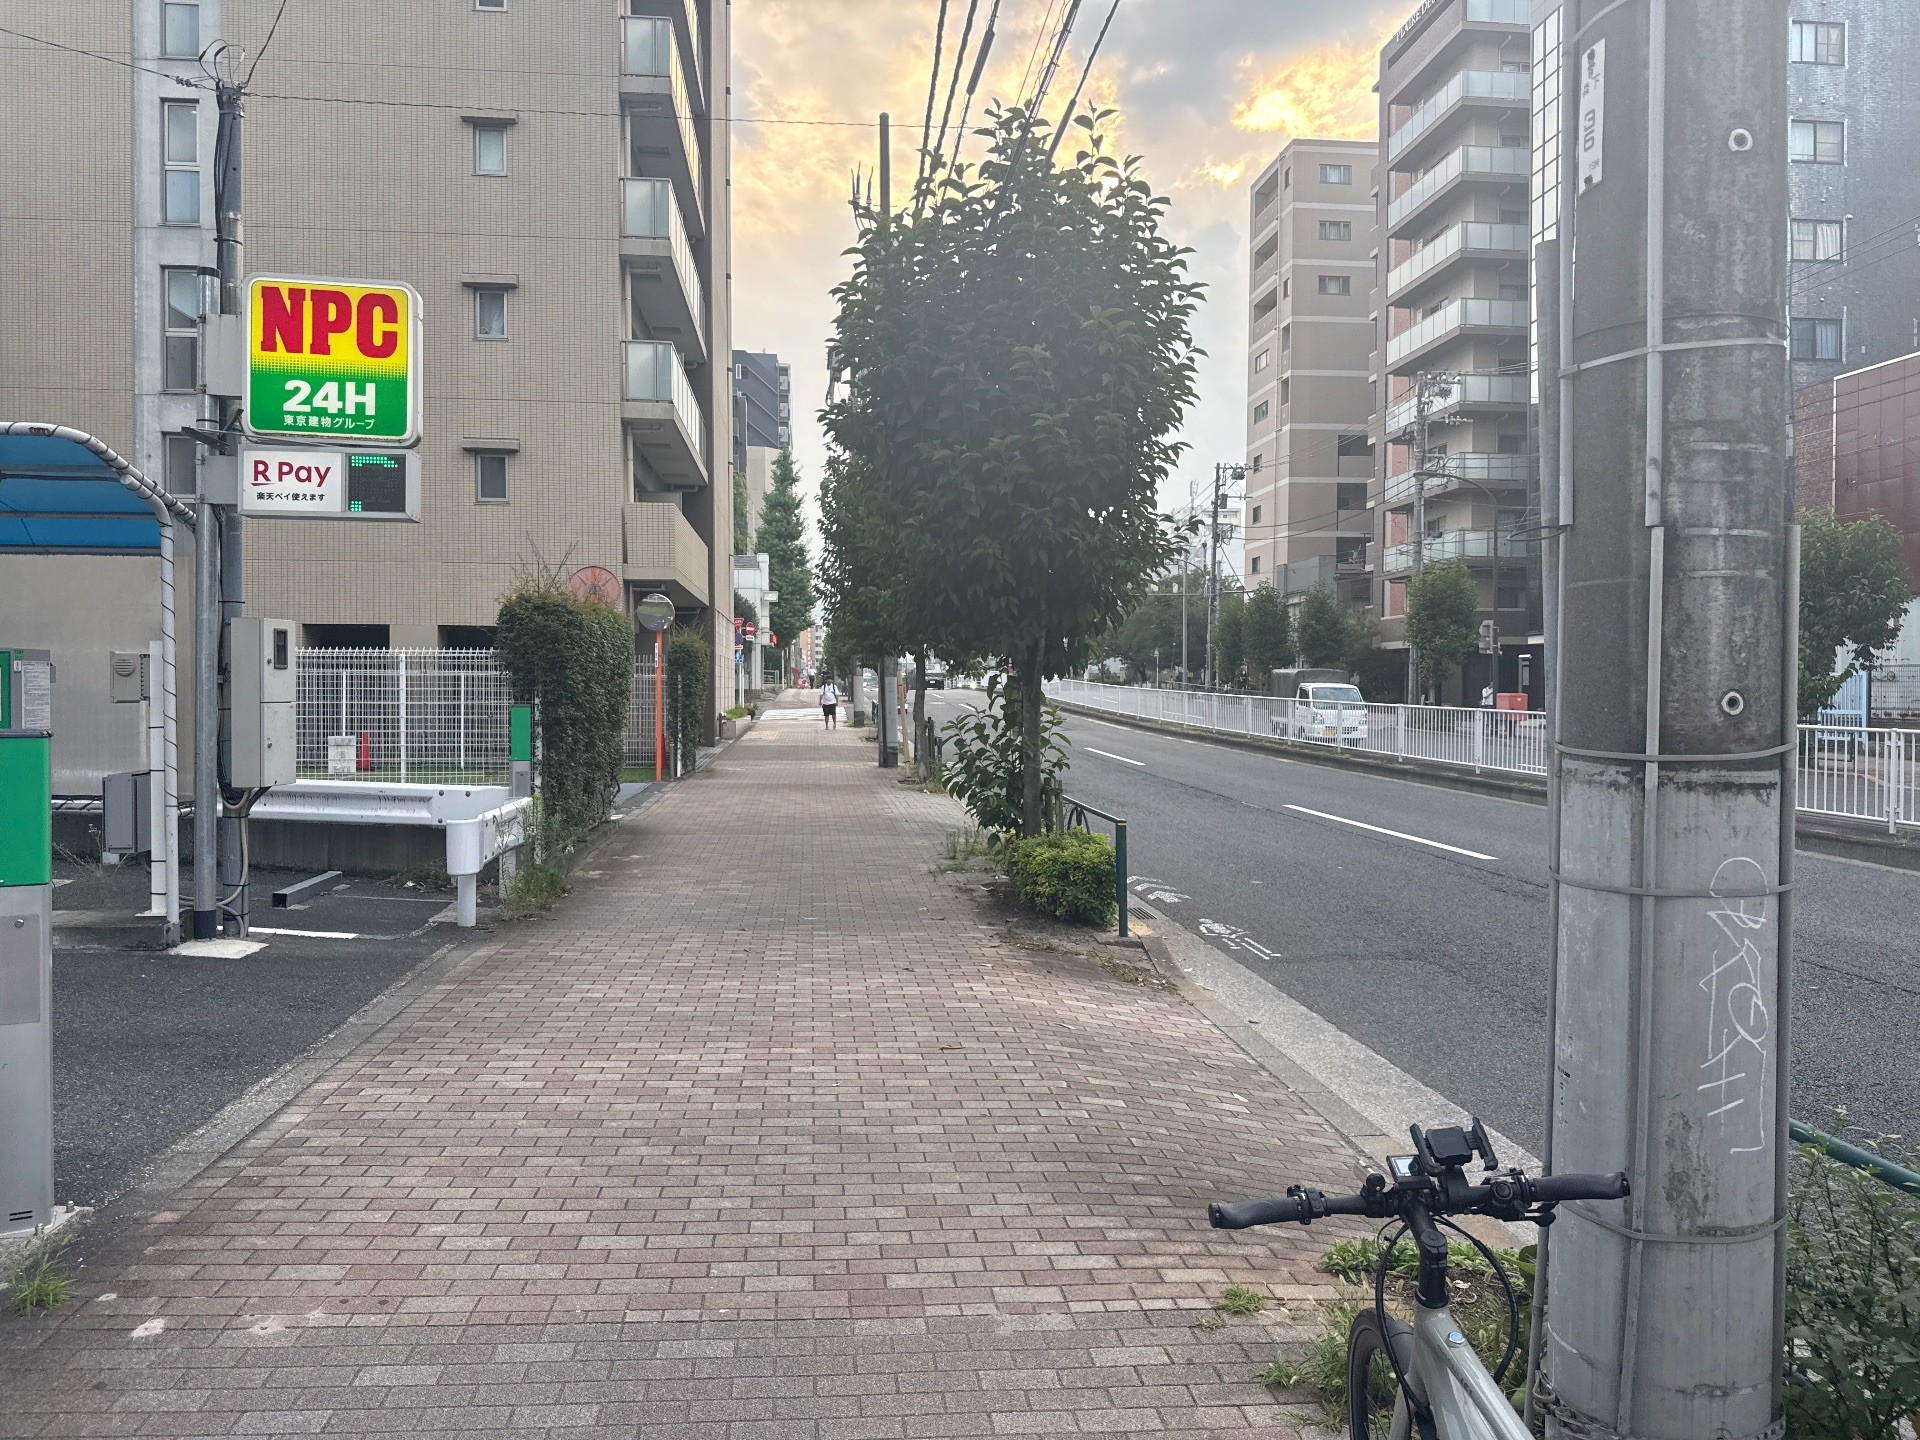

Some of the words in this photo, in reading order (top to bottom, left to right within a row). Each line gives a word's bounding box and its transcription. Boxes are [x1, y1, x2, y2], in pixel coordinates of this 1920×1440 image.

[261, 286, 398, 358] NPC
[282, 379, 376, 416] 24H
[283, 413, 376, 430] 東京建物グループ
[252, 460, 272, 485] R
[278, 461, 331, 487] Pay
[256, 491, 326, 502] 楽天ペイ使えます
